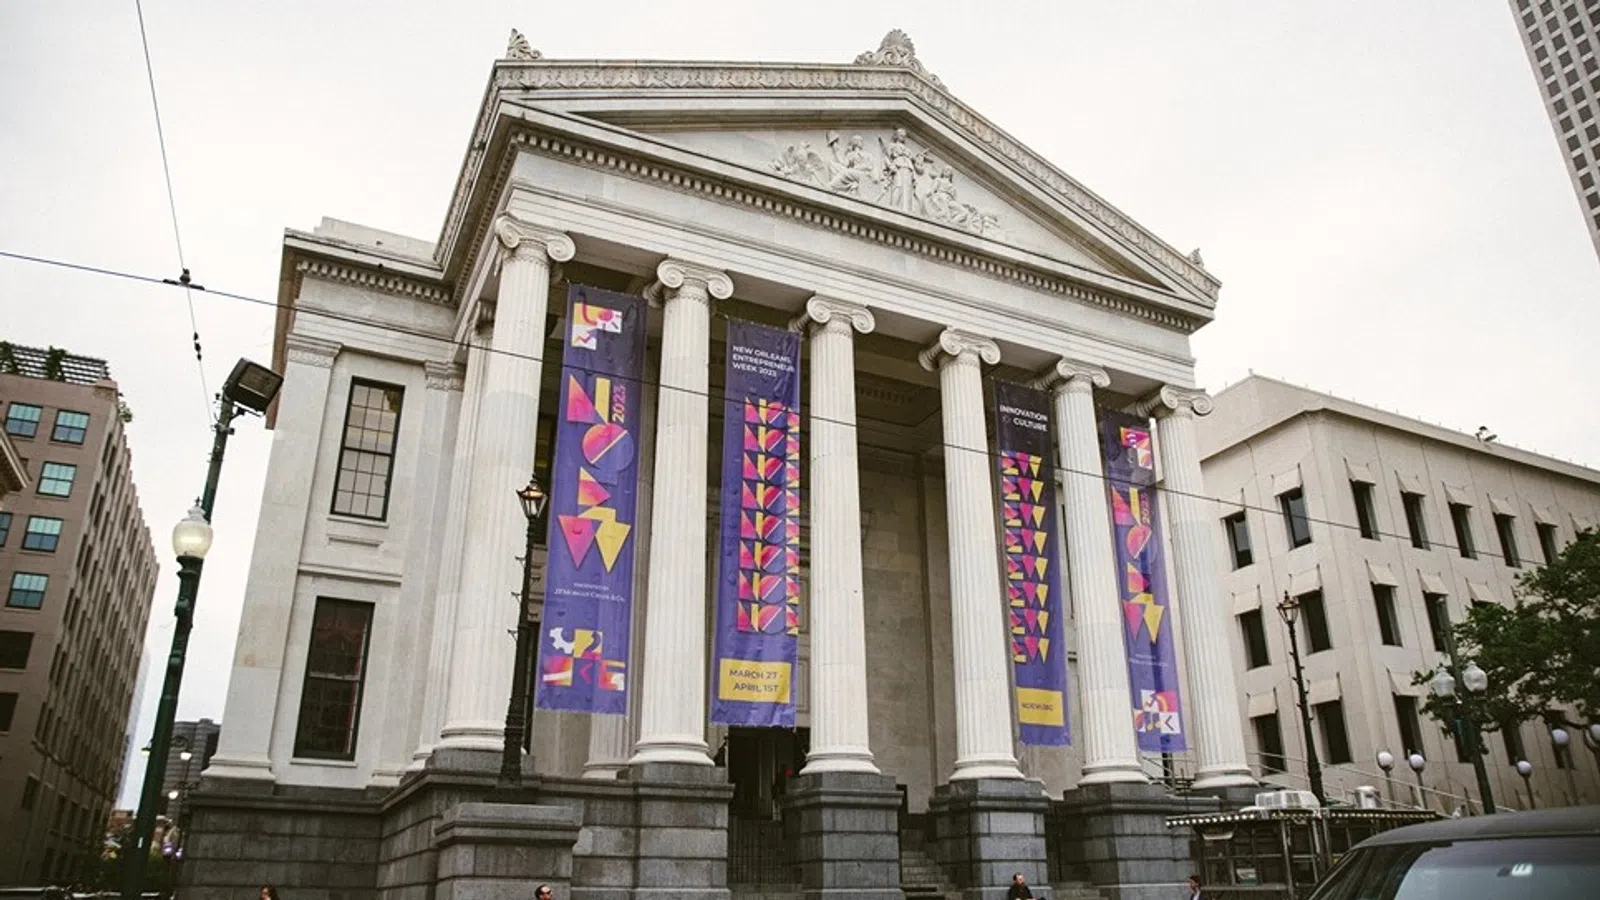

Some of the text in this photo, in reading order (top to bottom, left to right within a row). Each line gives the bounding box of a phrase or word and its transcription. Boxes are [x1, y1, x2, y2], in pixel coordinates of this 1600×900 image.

[732, 345, 753, 354] NEW
[732, 362, 757, 373] WEEK
[1000, 404, 1048, 422] INNOVATION
[1012, 417, 1048, 432] CULTURE
[729, 668, 764, 680] MARCH
[733, 682, 761, 693] APRIL
